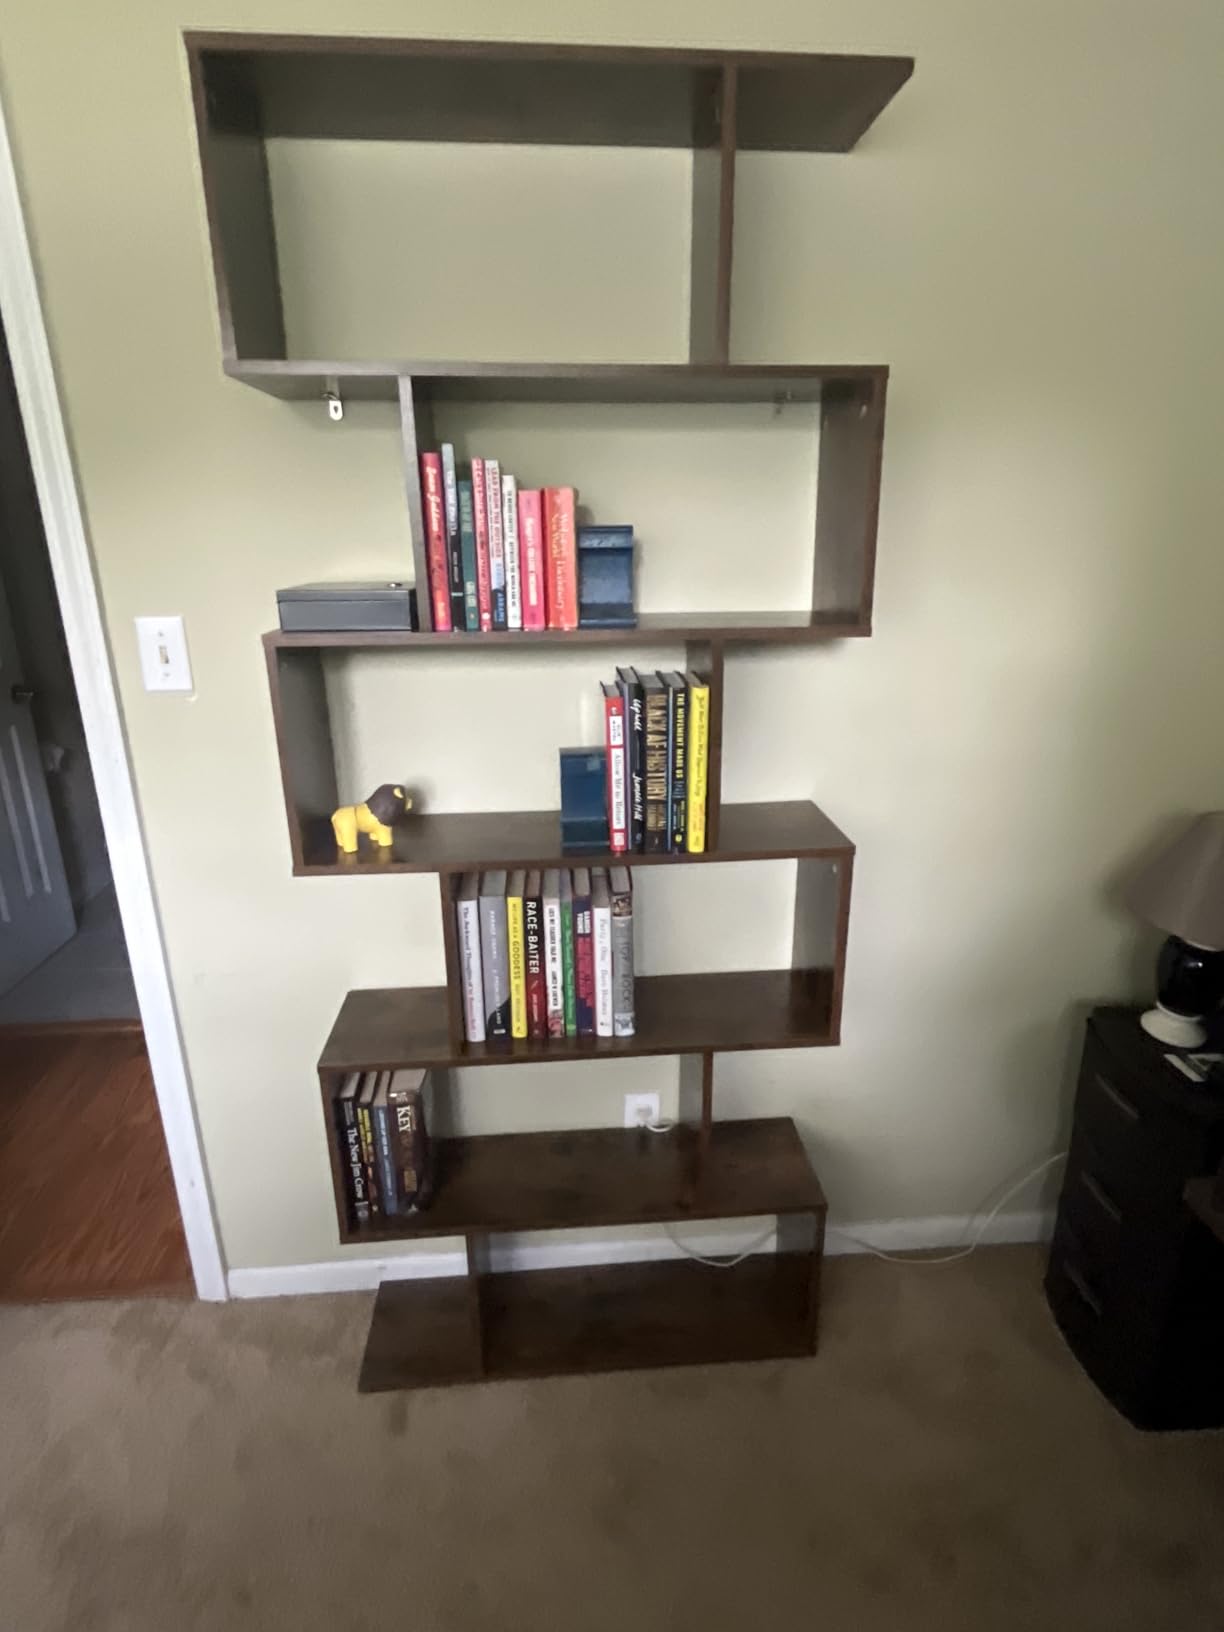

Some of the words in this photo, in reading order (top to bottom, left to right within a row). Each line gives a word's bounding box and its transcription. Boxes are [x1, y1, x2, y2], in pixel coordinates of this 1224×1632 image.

[677, 693, 686, 706] THE
[645, 694, 668, 732] BLACK
[676, 708, 686, 746] MOVEMENT
[646, 734, 667, 749] AF
[675, 748, 685, 768] MADE
[645, 750, 667, 801] HISTORY
[675, 769, 685, 779] US
[526, 901, 540, 974] RACE-BAITER
[513, 940, 522, 980] GODDESS
[396, 1104, 412, 1133] KEY
[346, 1127, 358, 1144] The
[350, 1143, 360, 1163] New
[350, 1163, 362, 1178] Jim
[354, 1178, 364, 1199] Crow
